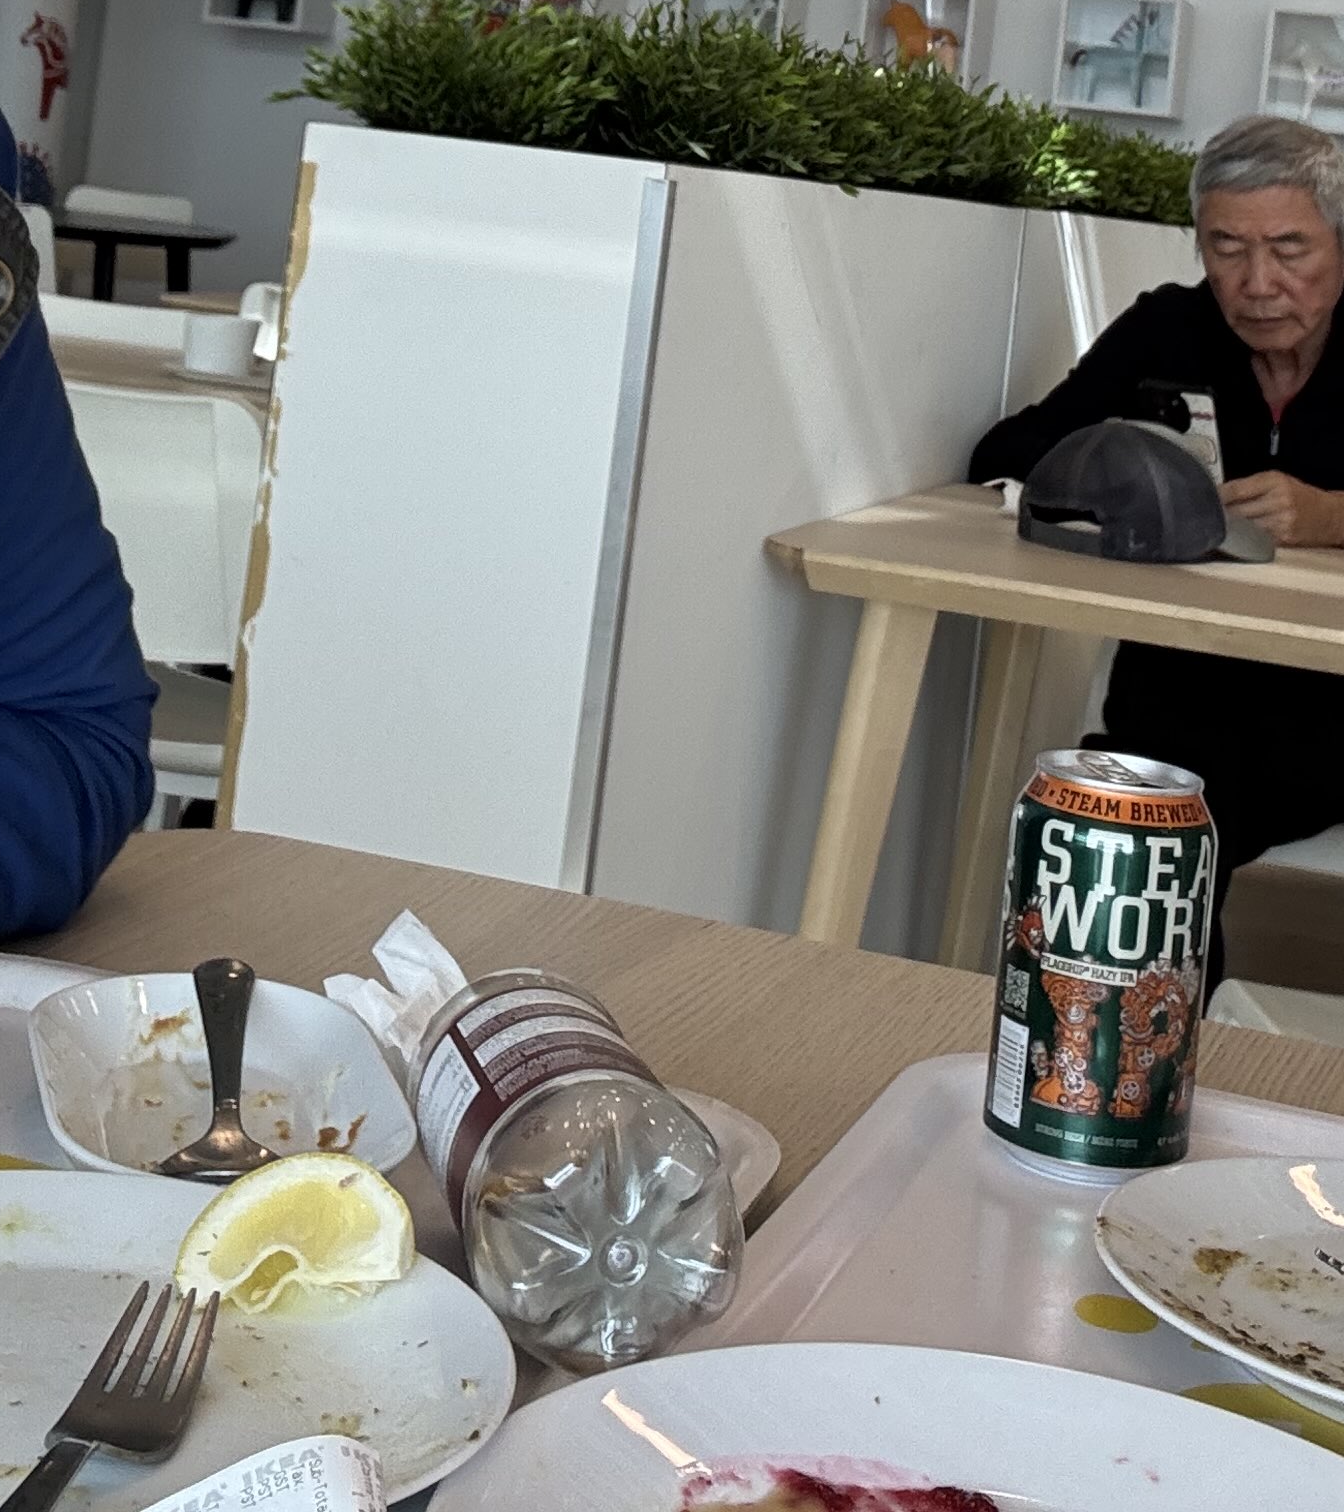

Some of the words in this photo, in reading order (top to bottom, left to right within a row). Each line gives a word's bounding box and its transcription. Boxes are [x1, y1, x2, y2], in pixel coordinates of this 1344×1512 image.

[1056, 788, 1122, 820] STEAM
[1130, 801, 1200, 824] BREWED
[308, 1458, 332, 1512] Sub-Tota
